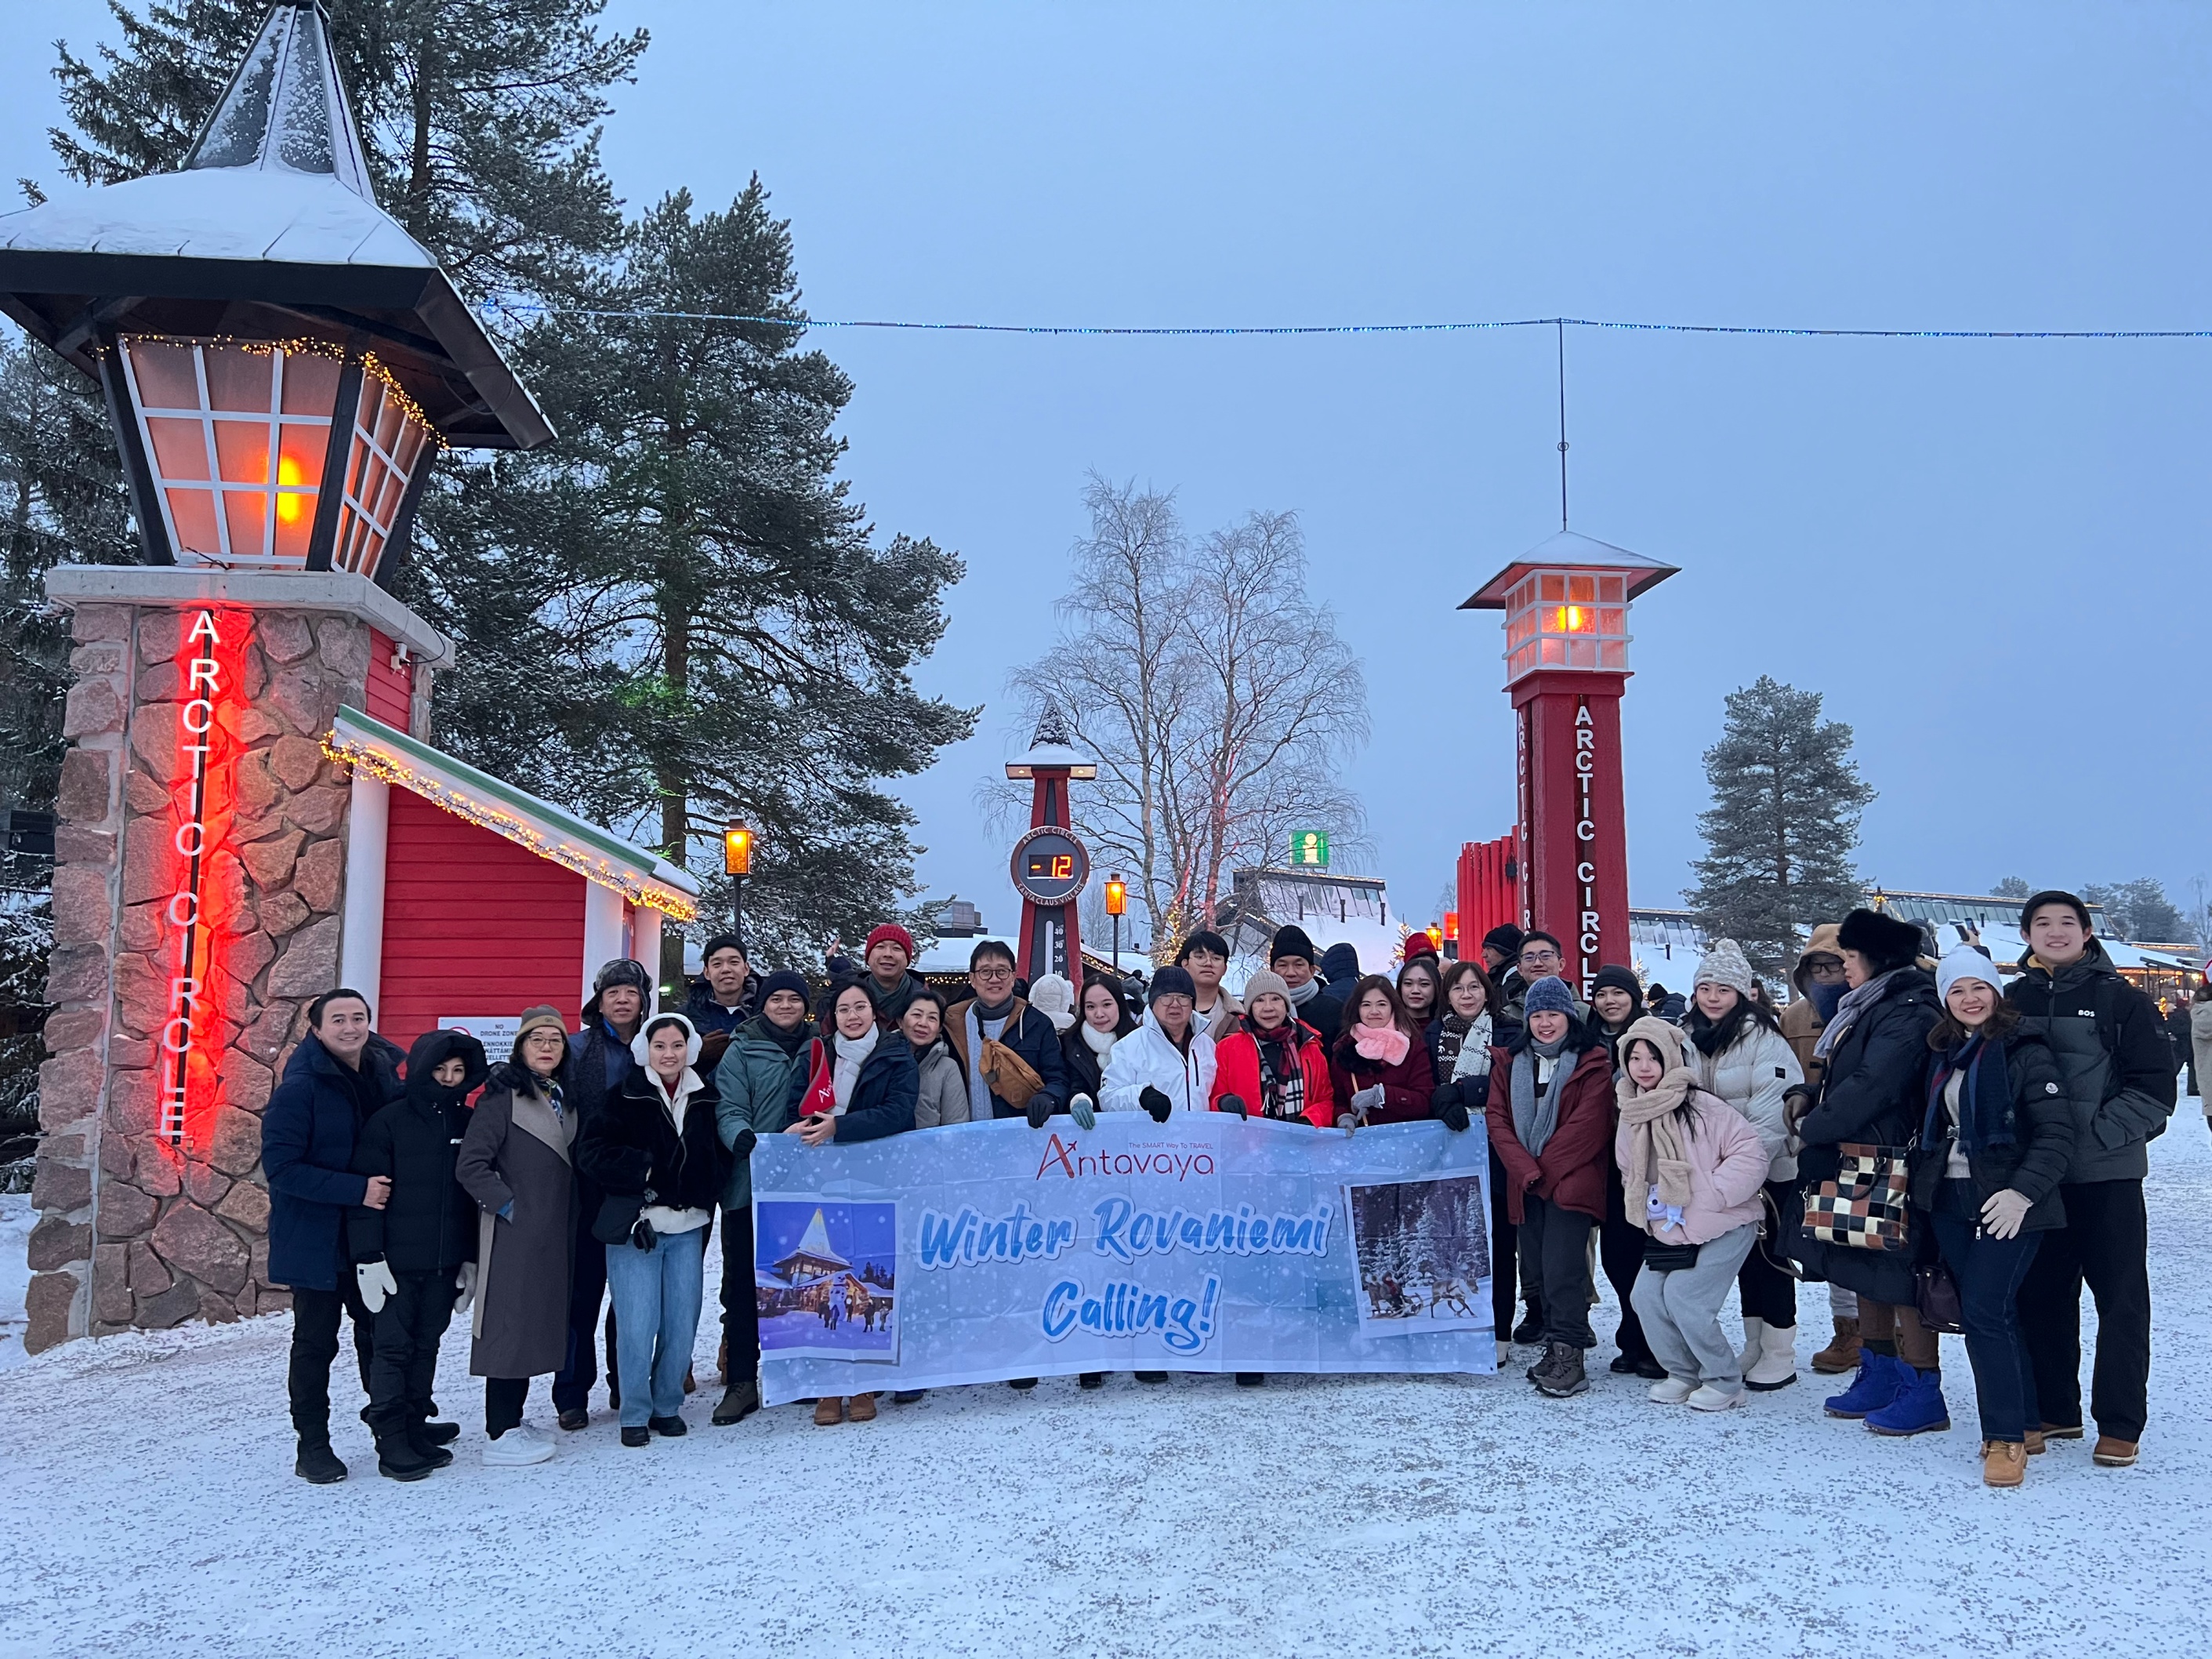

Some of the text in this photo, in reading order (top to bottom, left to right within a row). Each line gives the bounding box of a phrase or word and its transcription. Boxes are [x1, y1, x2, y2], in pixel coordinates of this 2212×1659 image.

[1022, 827, 1079, 845] ARCTIC CIRCLE
[1518, 711, 1531, 937] ARCTIC CIR
[1574, 705, 1601, 1001] ARCTIC CIRCLE
[160, 610, 220, 1136] ARCTIC CIRCLE
[1016, 882, 1085, 906] SANTA CLAUS VILLAGE
[1036, 1133, 1214, 1182] Antavaya
[919, 1196, 1329, 1265] Winter Rovaniemi
[1043, 1277, 1217, 1350] Calling!
